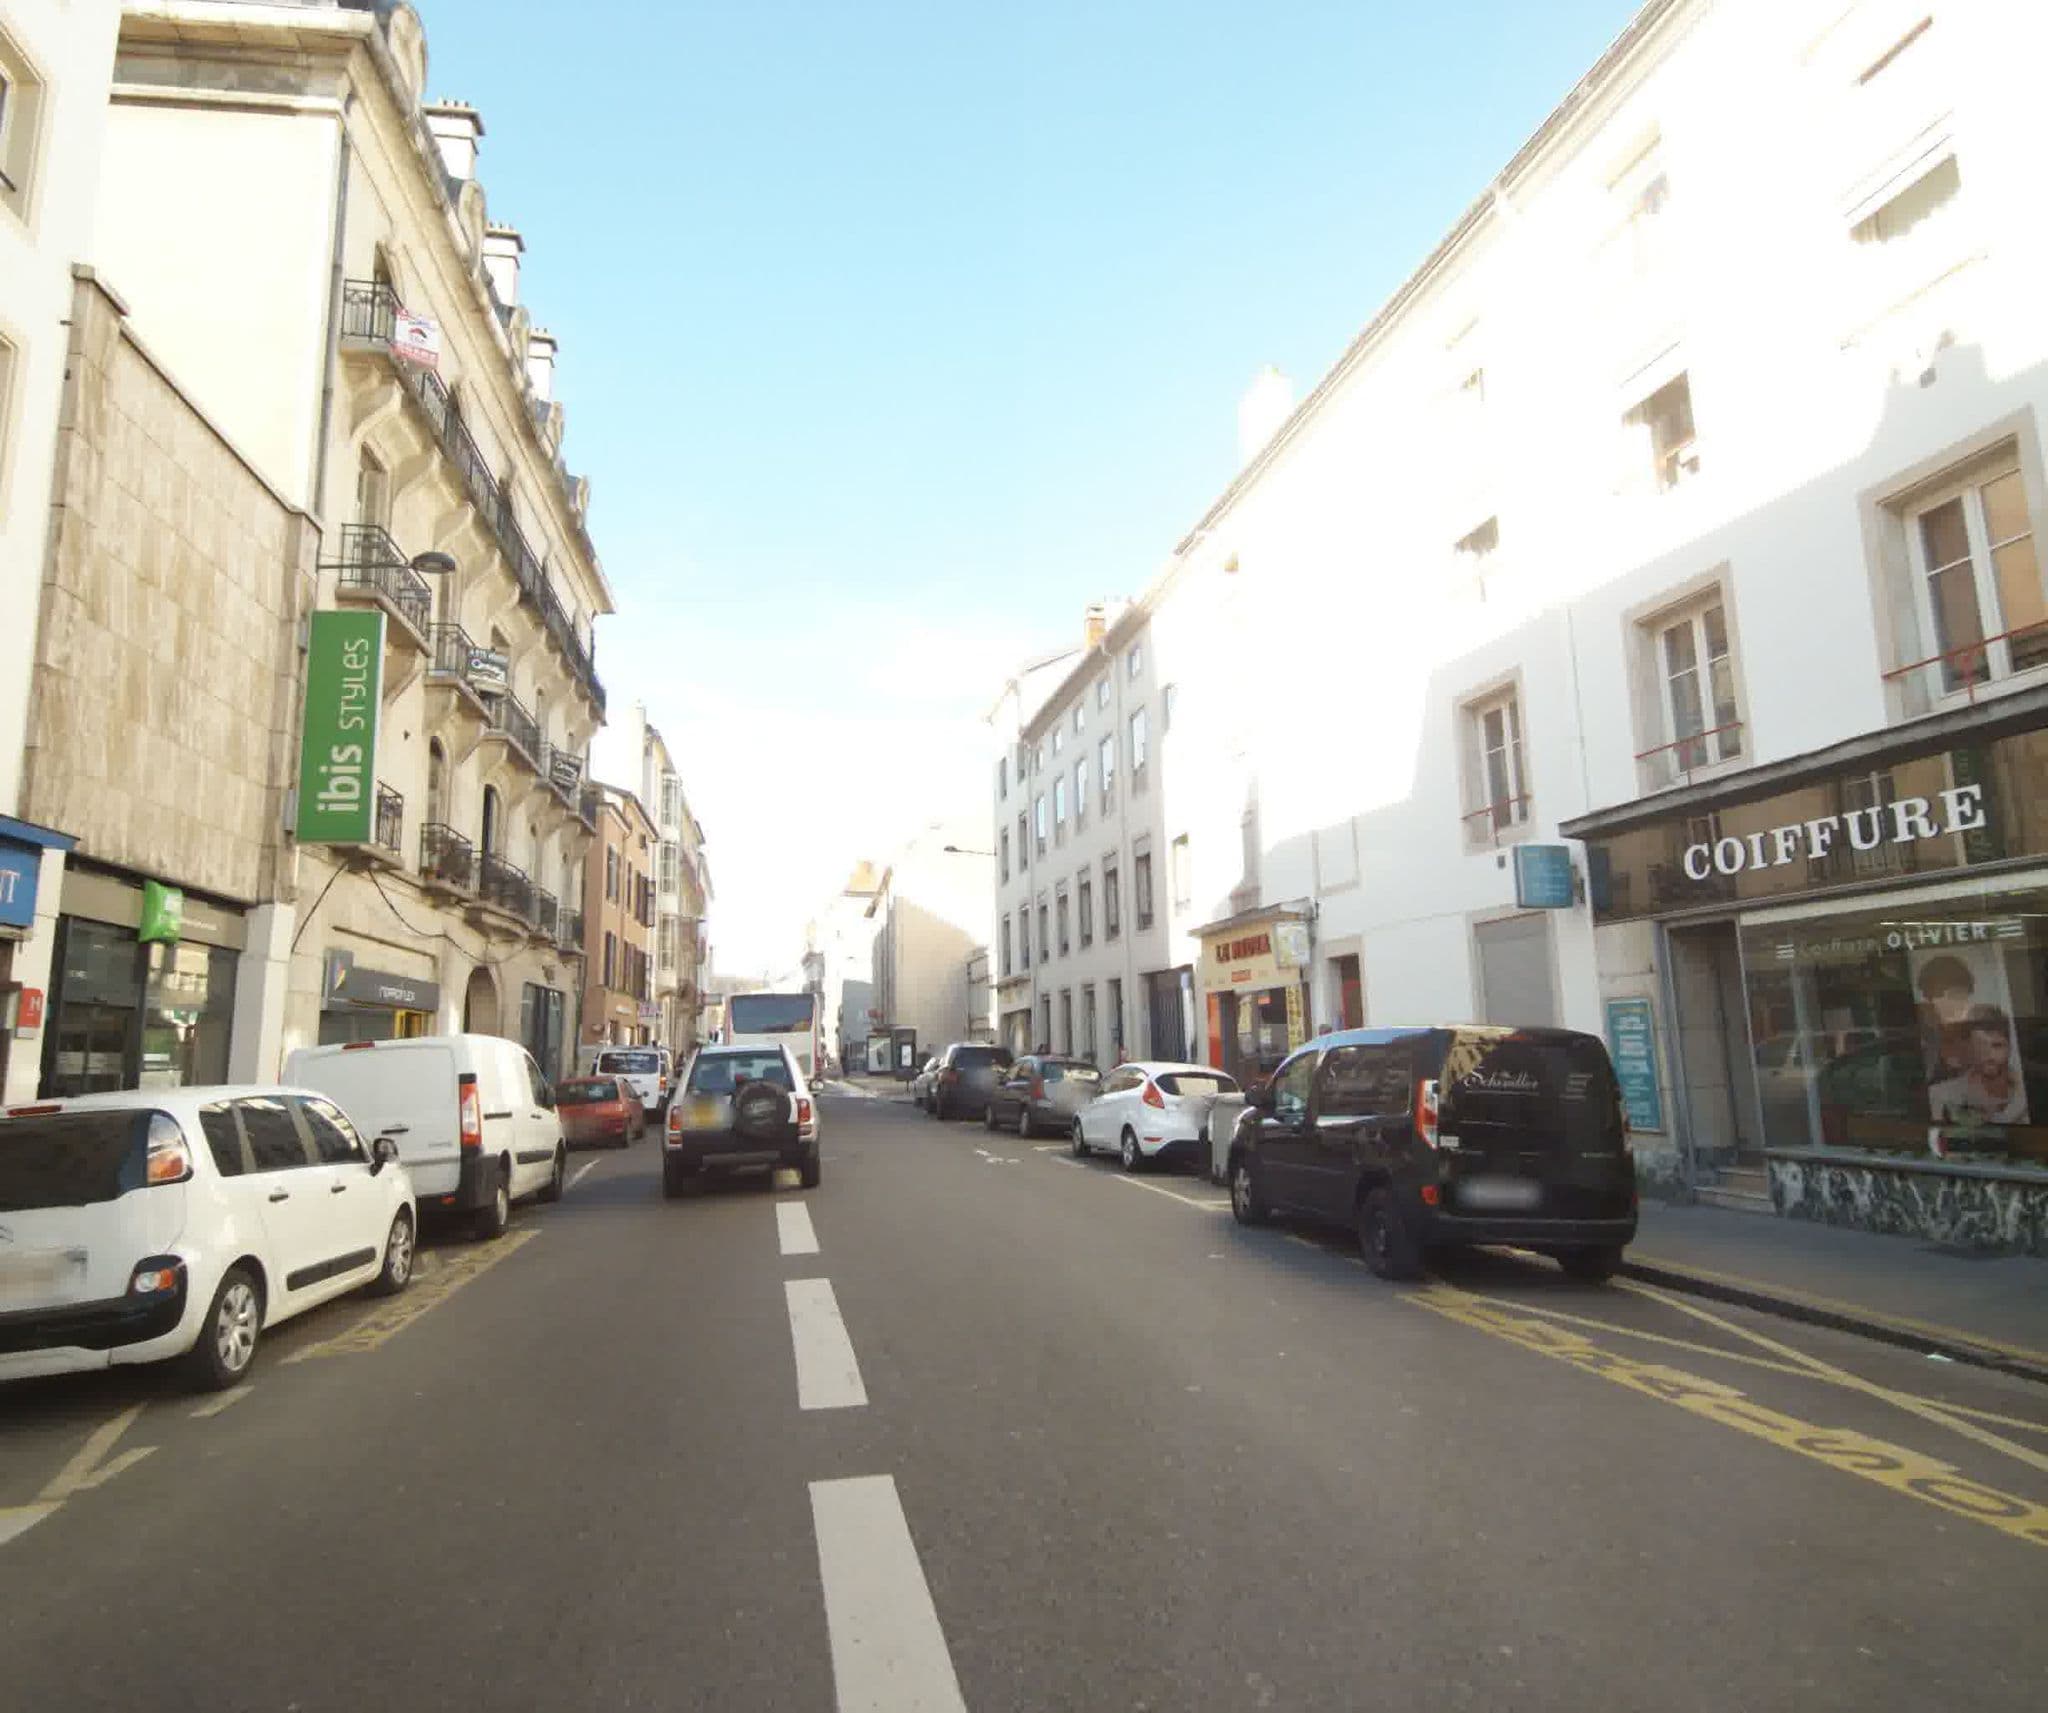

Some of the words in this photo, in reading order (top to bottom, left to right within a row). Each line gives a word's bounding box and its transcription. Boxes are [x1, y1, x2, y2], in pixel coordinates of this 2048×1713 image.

[316, 744, 363, 812] ibis
[1683, 783, 1987, 881] COIFFURE
[1886, 922, 1988, 950] OLIVIER
